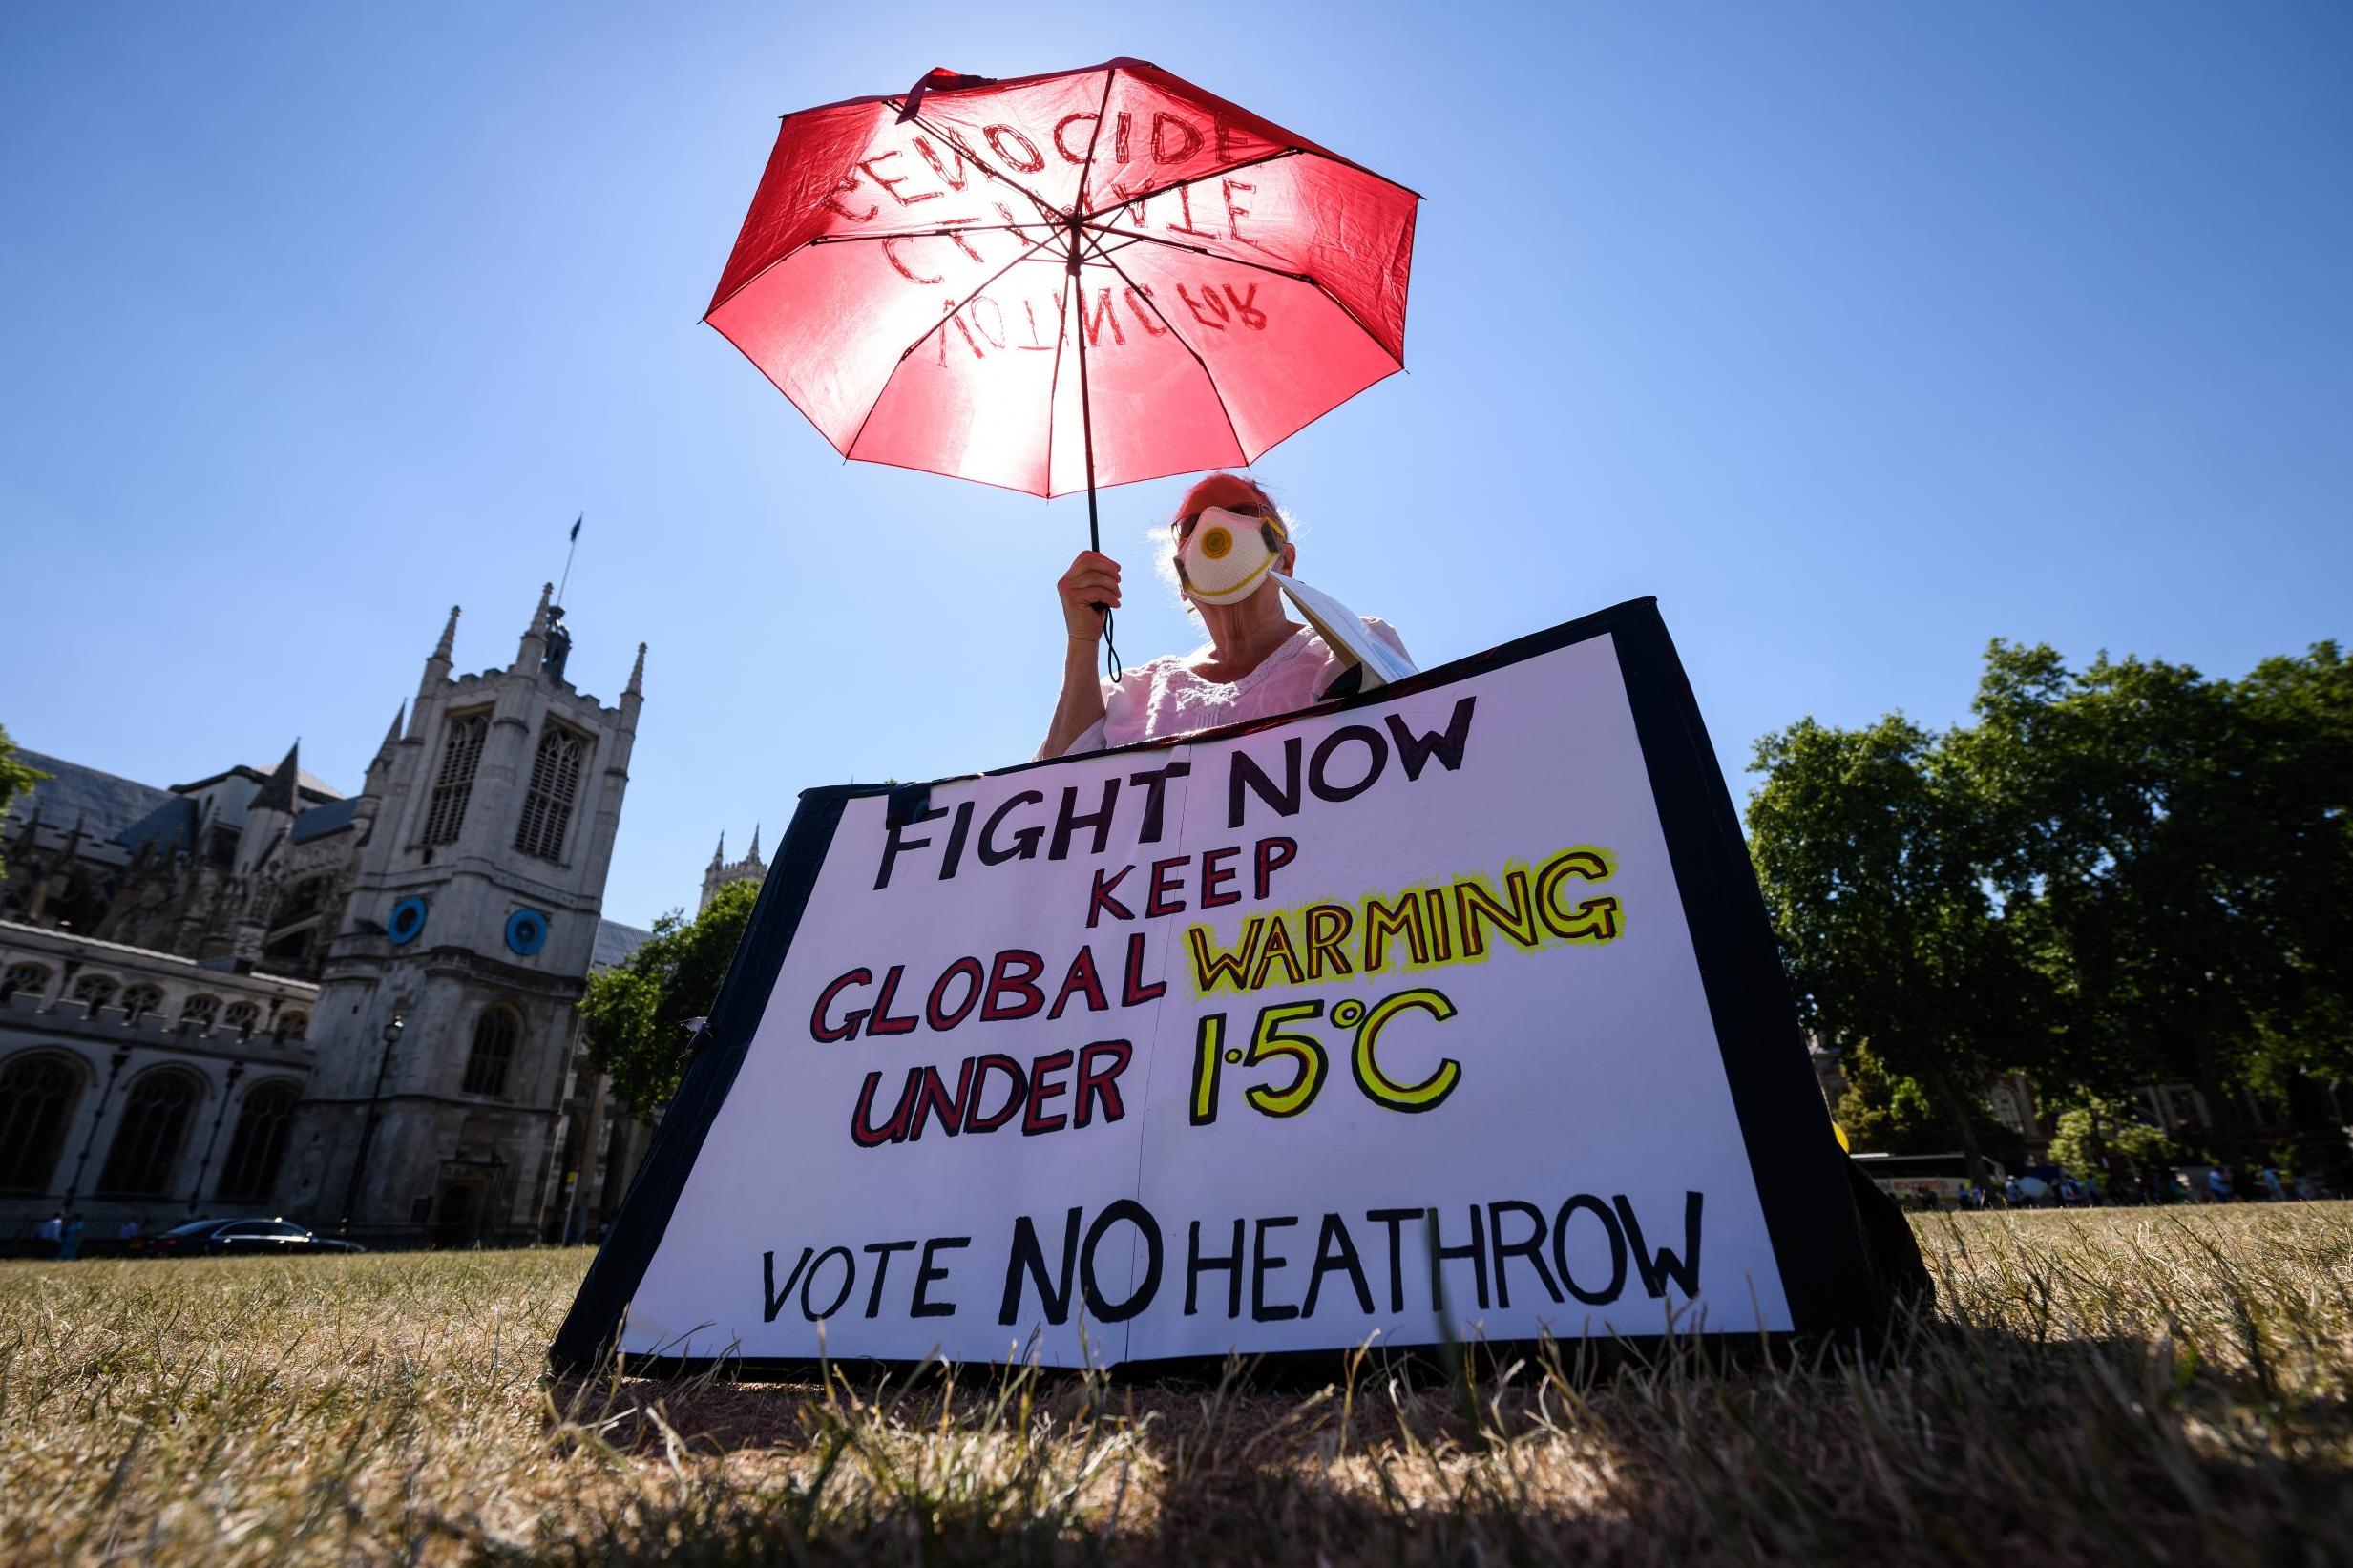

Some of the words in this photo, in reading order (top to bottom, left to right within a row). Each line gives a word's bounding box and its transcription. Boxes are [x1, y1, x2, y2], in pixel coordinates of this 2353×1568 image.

[872, 762, 1191, 890] FIGHT
[1228, 696, 1477, 828] NOW
[809, 932, 1167, 1043] GLOBAL
[1189, 851, 1618, 993] WARMING
[1085, 836, 1298, 929] KEEP
[851, 1039, 1133, 1148] UNDER
[763, 1236, 972, 1323] VOTE
[998, 1199, 1164, 1326] NO
[1184, 1190, 1704, 1323] HEATHROW
